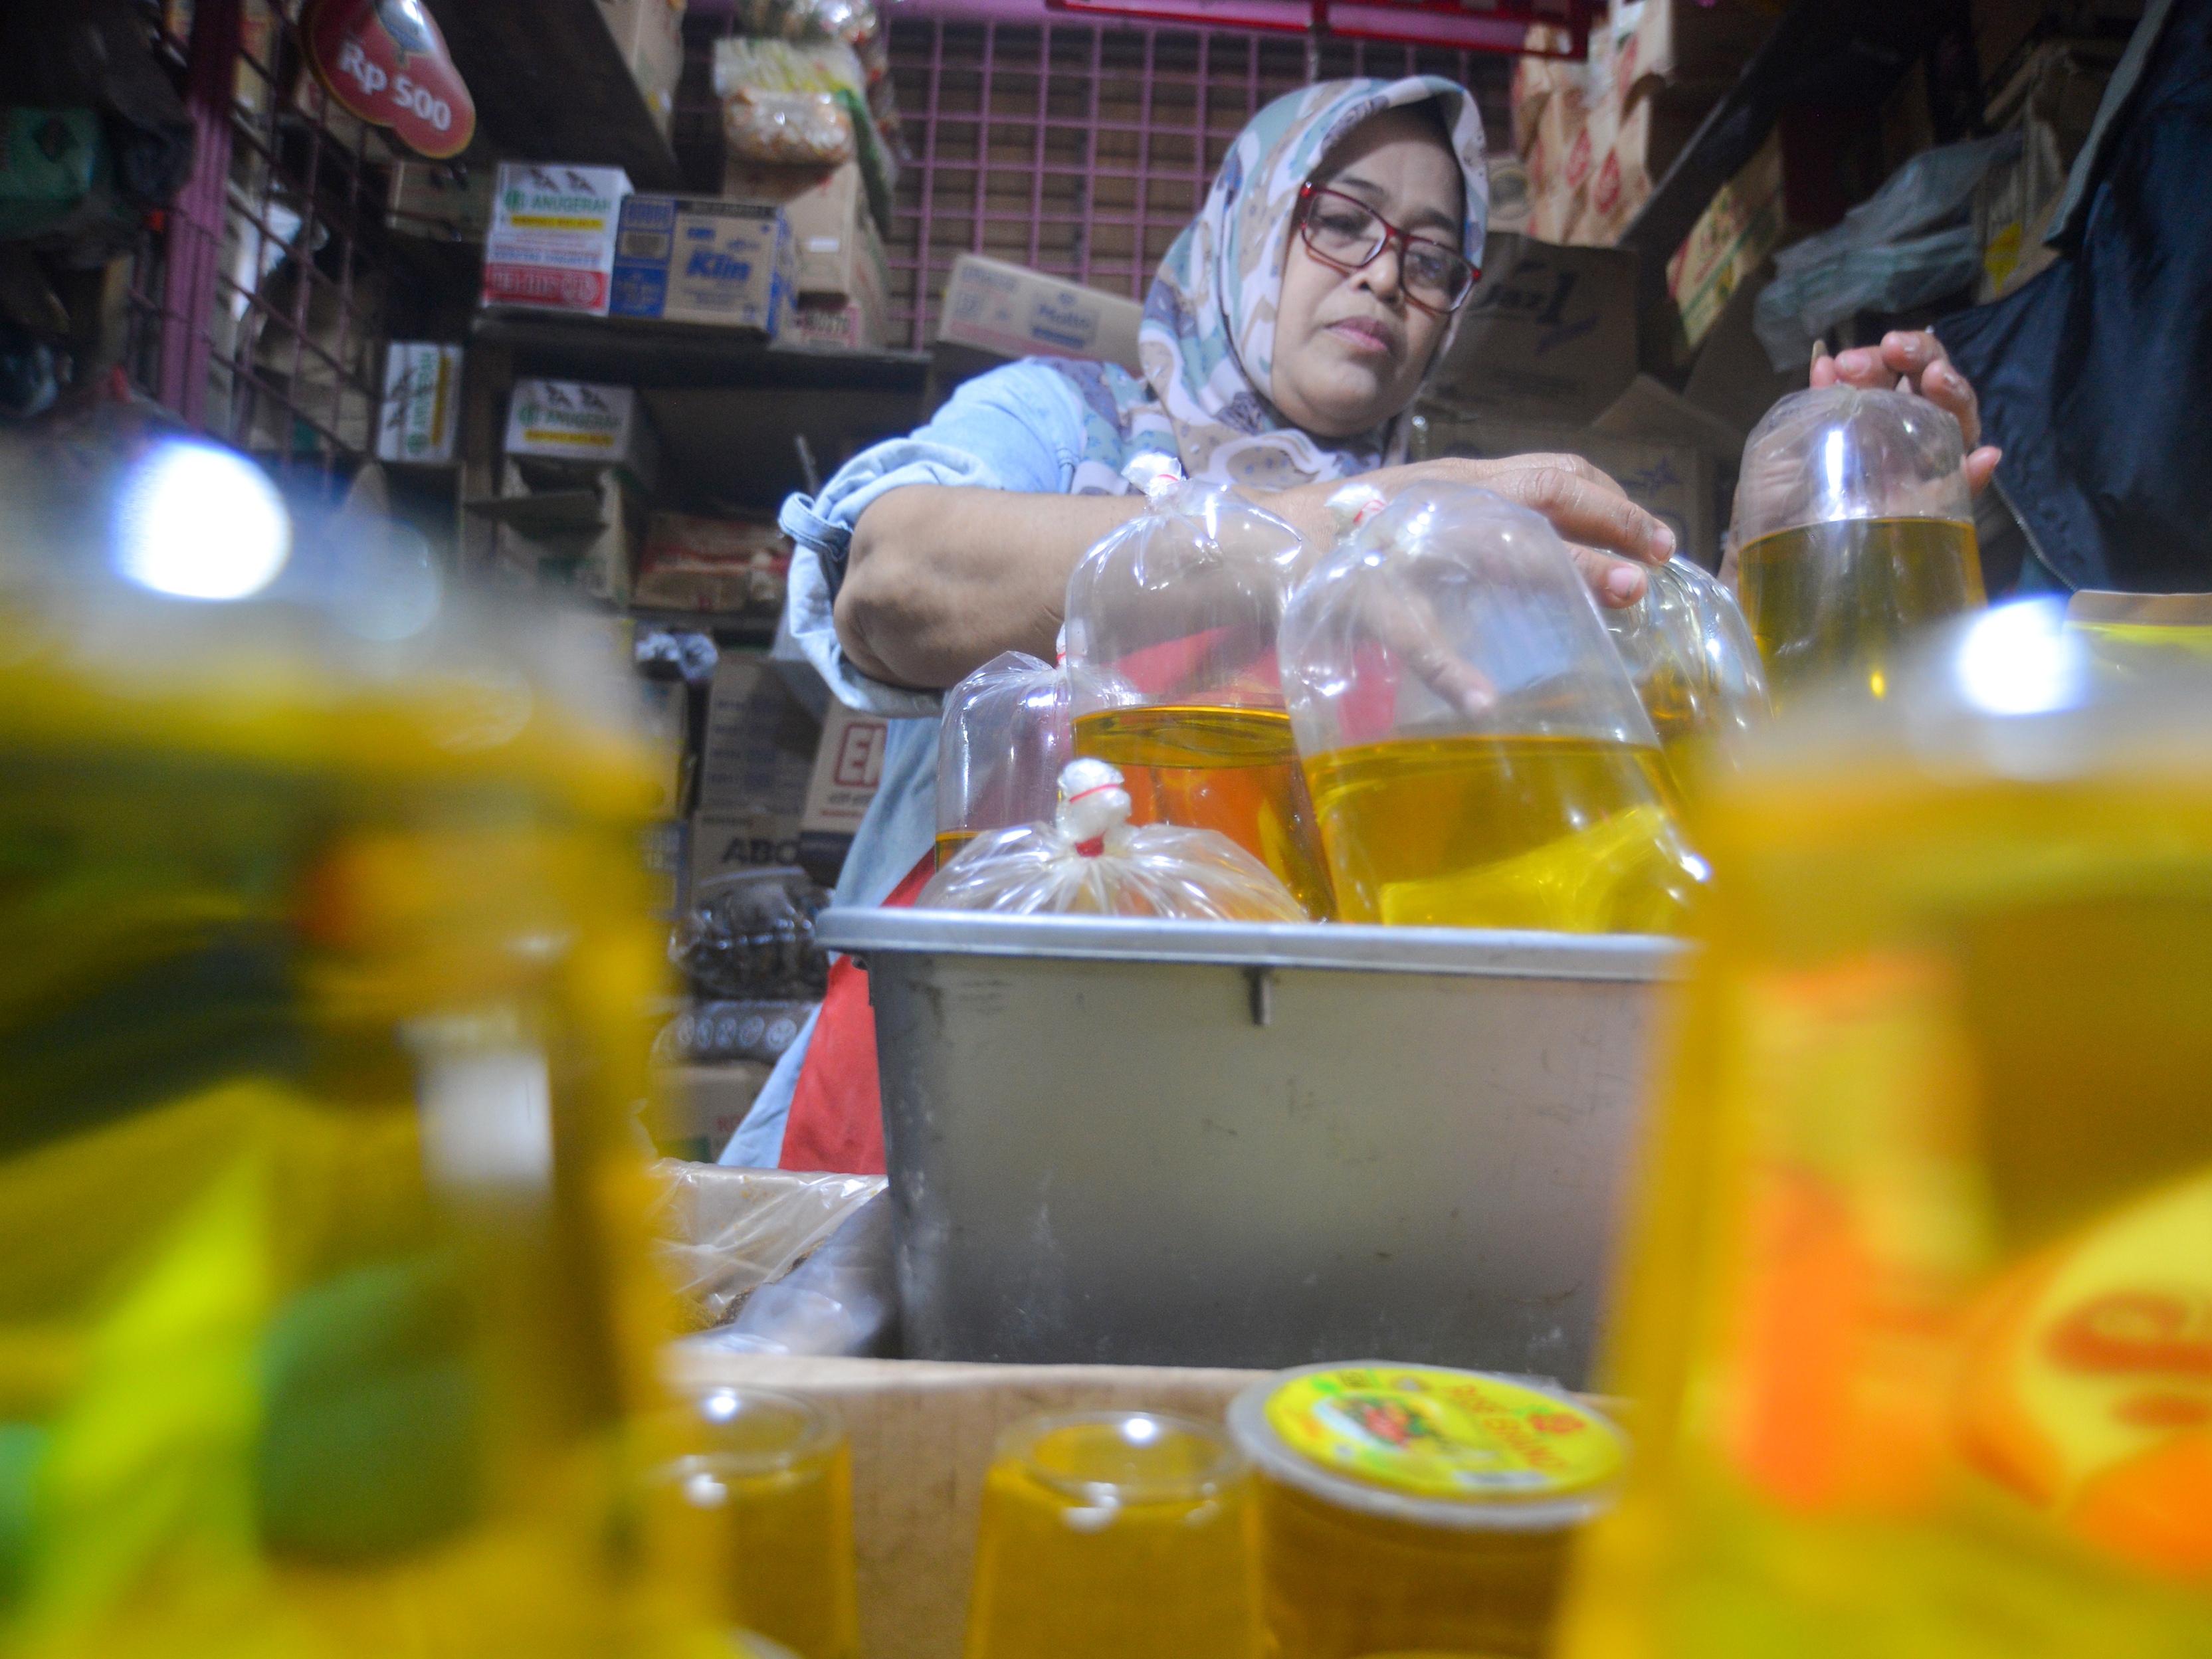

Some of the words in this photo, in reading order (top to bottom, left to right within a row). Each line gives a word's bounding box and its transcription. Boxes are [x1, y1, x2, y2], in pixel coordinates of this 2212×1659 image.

[338, 41, 387, 95] Rp
[391, 73, 452, 131] 500
[686, 249, 752, 280] Klin
[722, 836, 800, 865] ABC
